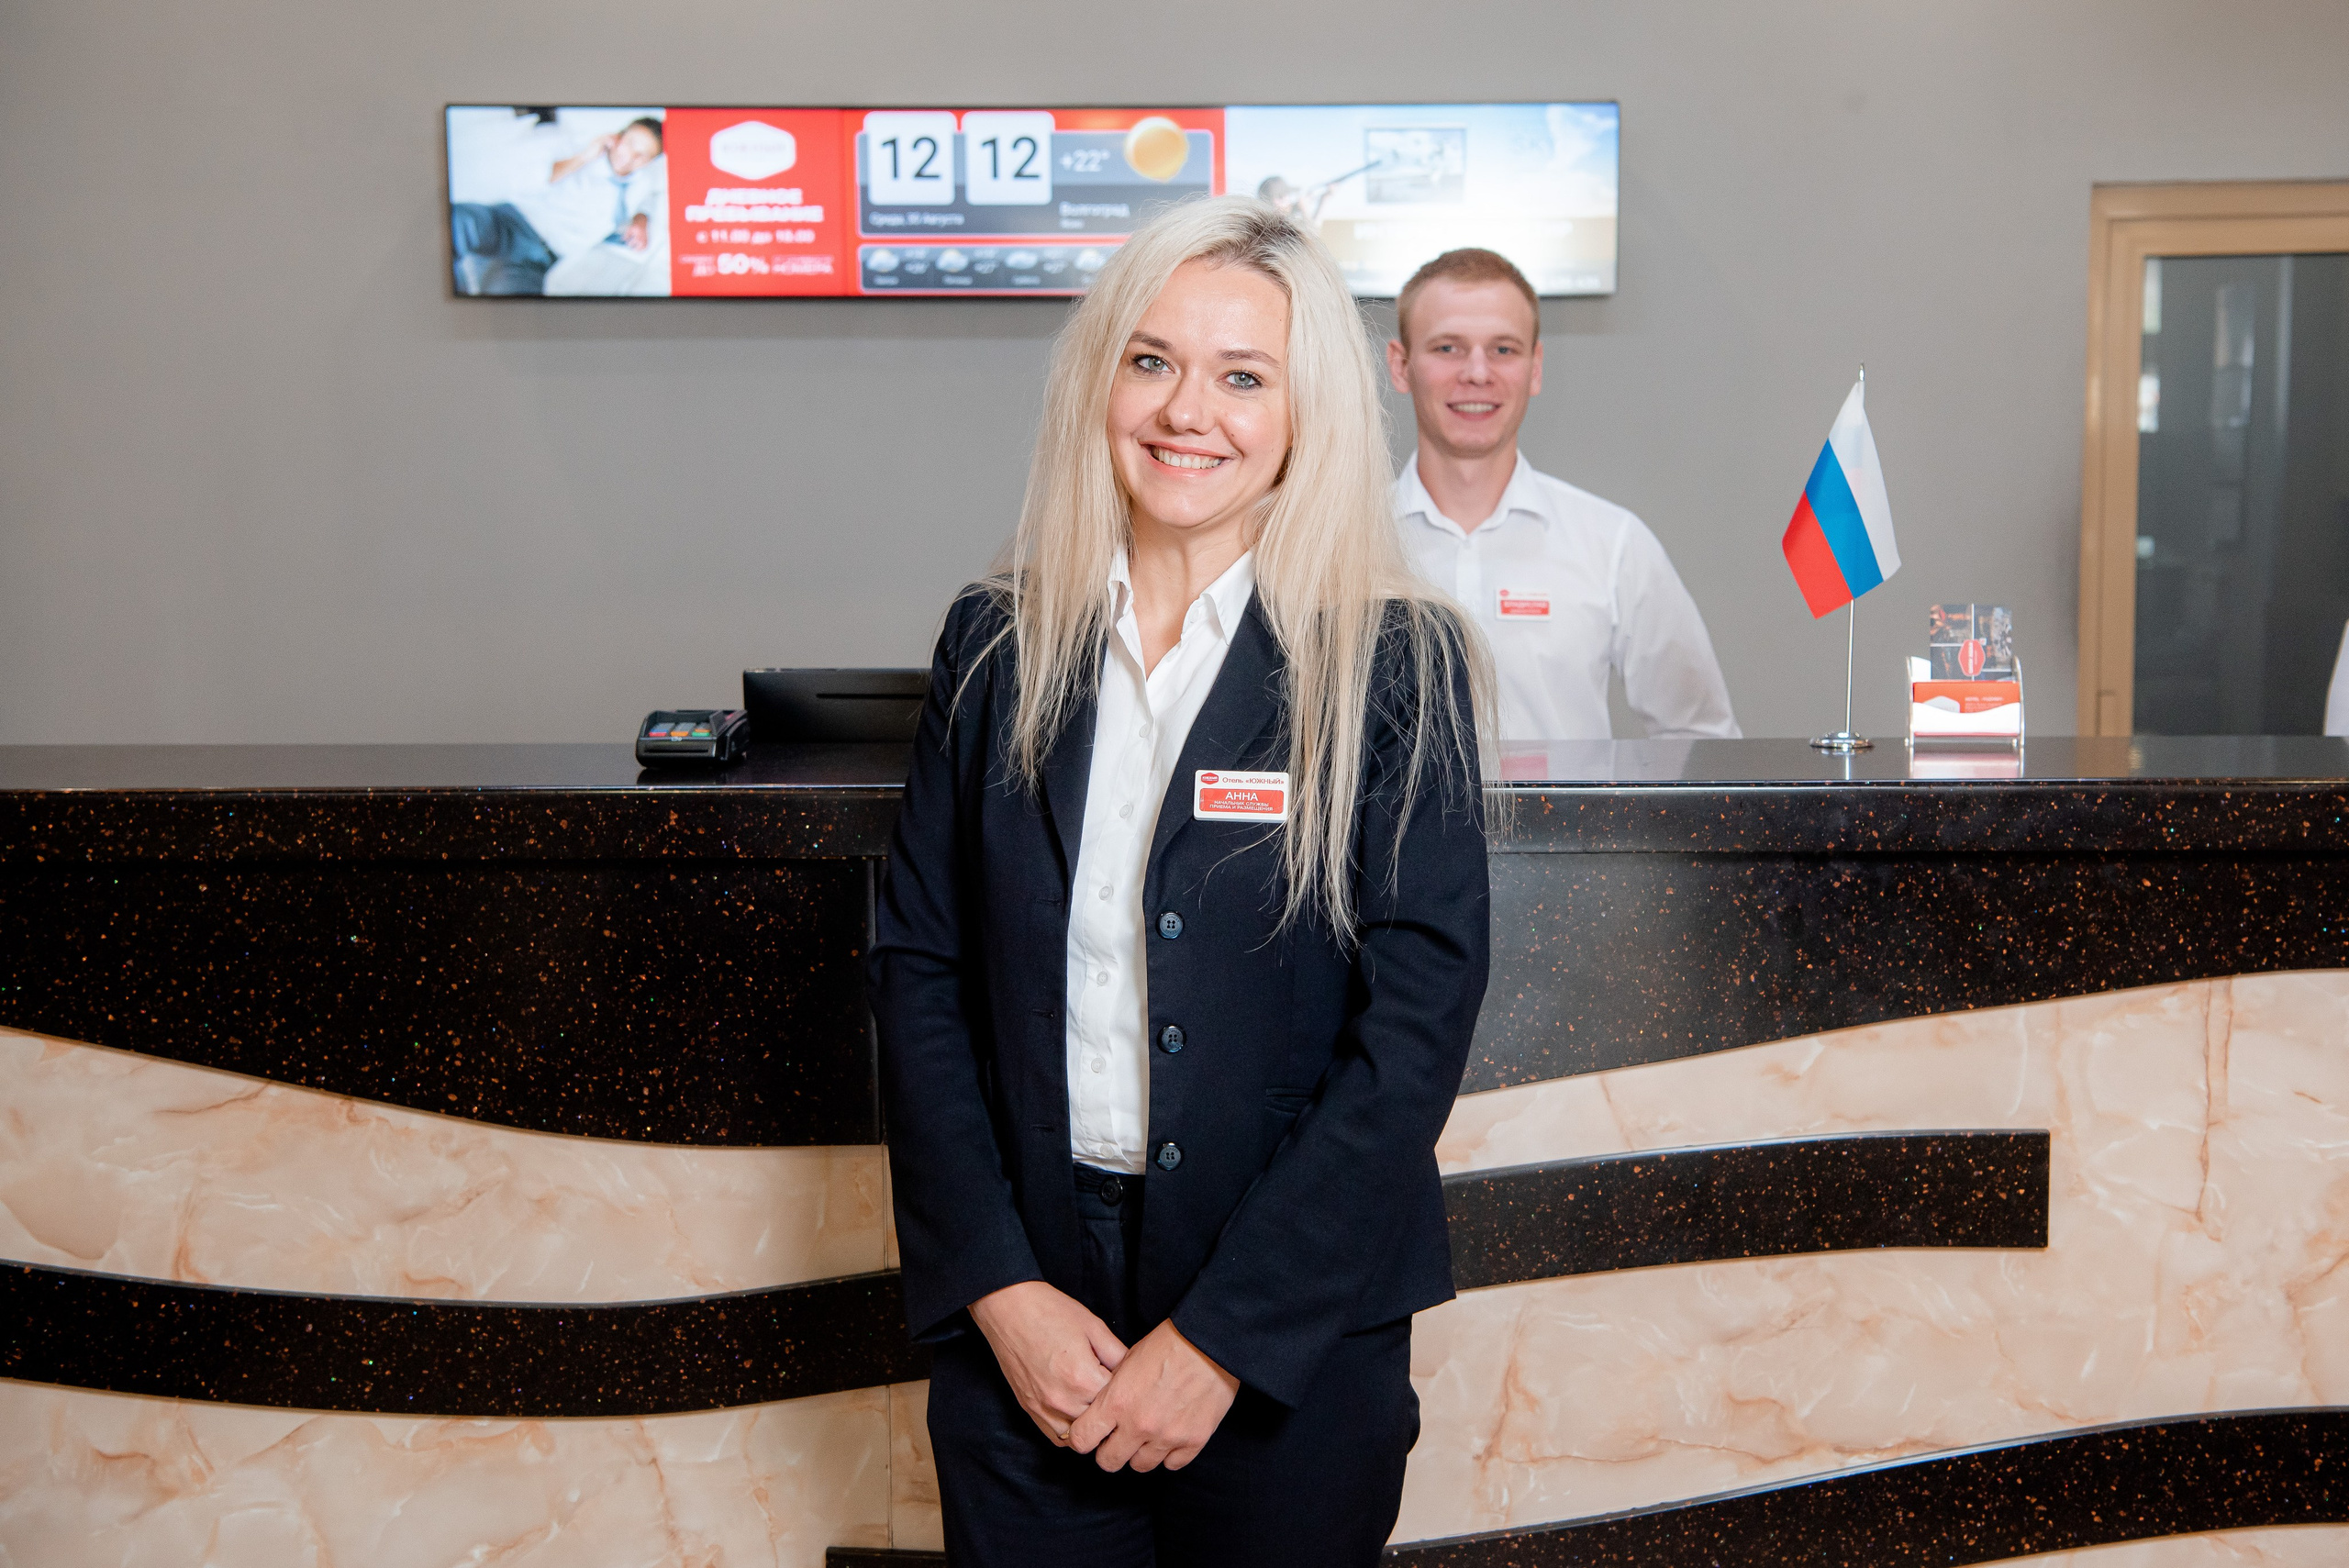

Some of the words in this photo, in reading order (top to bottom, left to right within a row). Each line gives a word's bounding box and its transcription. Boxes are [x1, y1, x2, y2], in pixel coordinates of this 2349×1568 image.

[881, 136, 941, 180] 12
[980, 136, 1041, 180] 12
[1225, 792, 1258, 801] АННА
